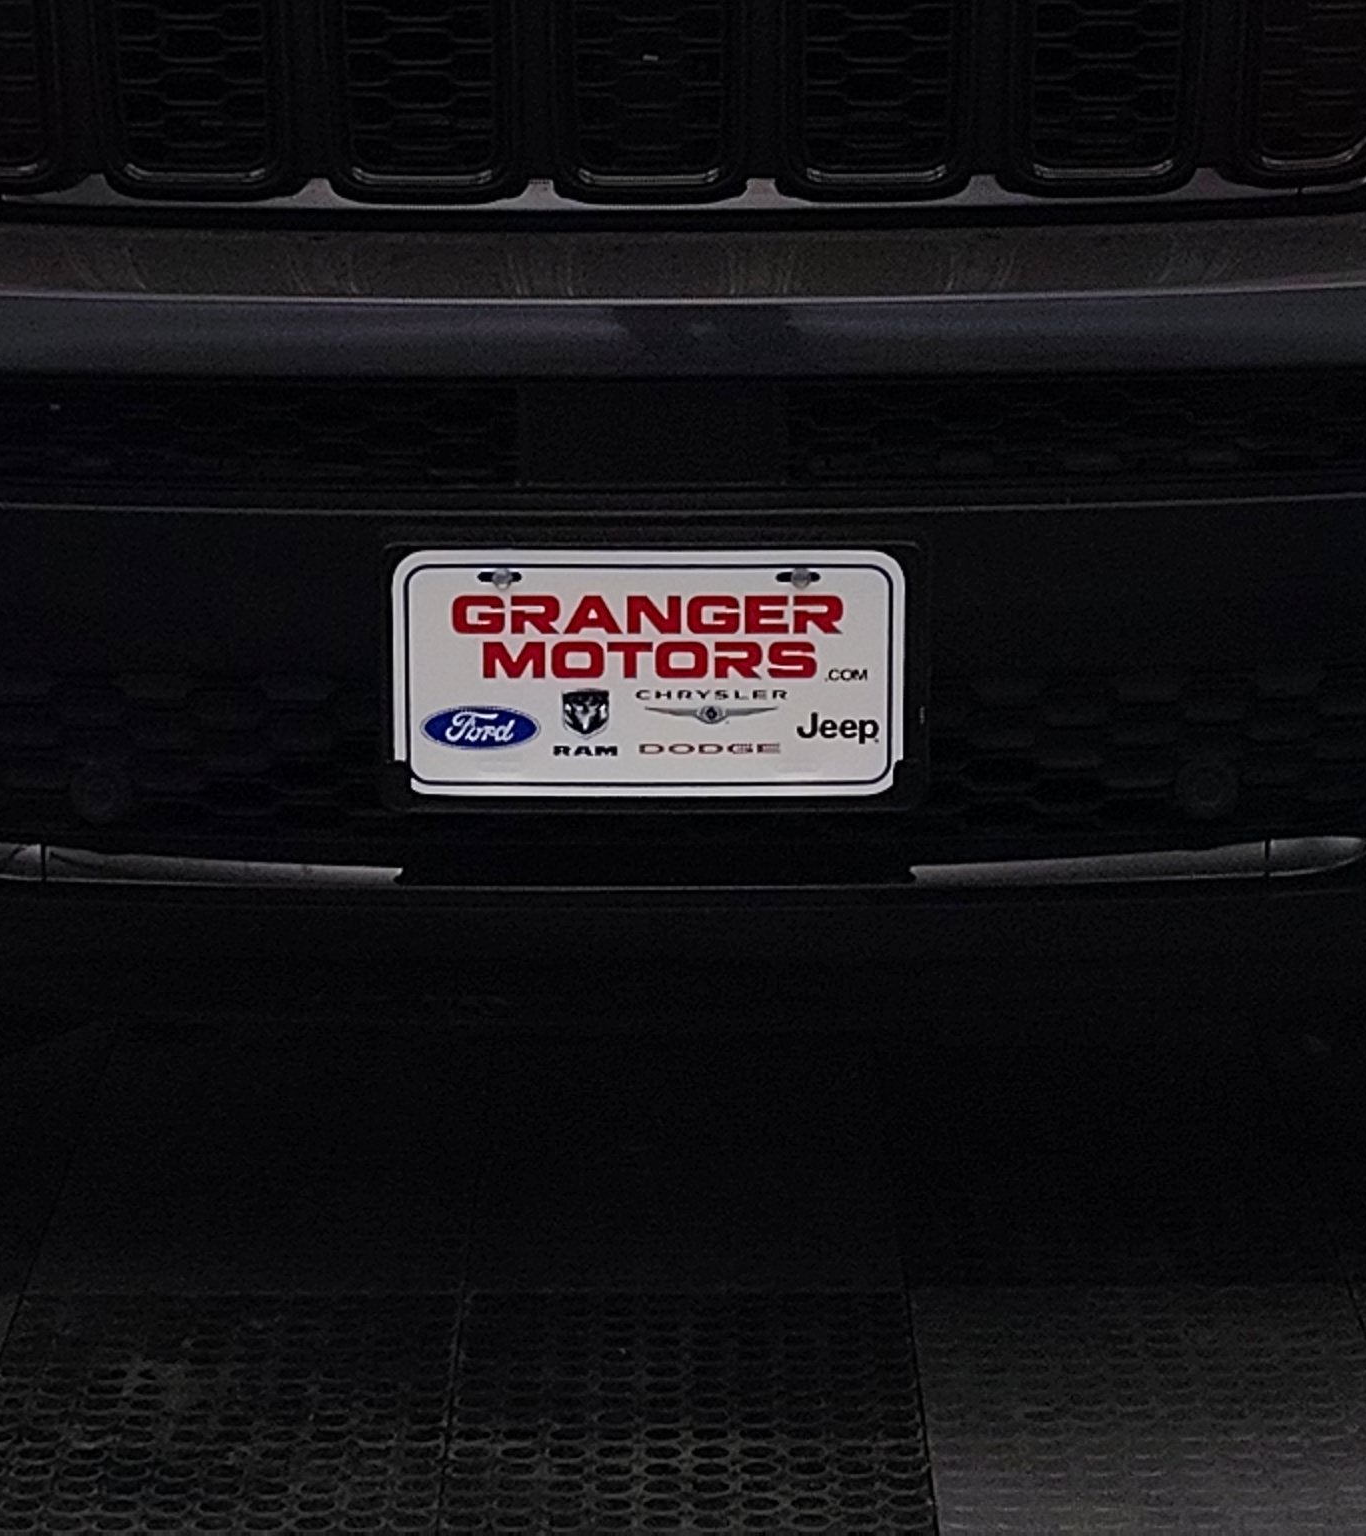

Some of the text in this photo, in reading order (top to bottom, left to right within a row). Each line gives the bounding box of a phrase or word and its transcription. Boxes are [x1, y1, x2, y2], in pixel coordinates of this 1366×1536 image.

[451, 595, 844, 634] GRANGER
[482, 641, 817, 679] MOTORS
[635, 689, 788, 700] CHRYSLER
[444, 710, 516, 743] Ford
[796, 712, 880, 745] Jeep
[552, 745, 619, 757] RAM
[638, 743, 782, 755] DODGE
